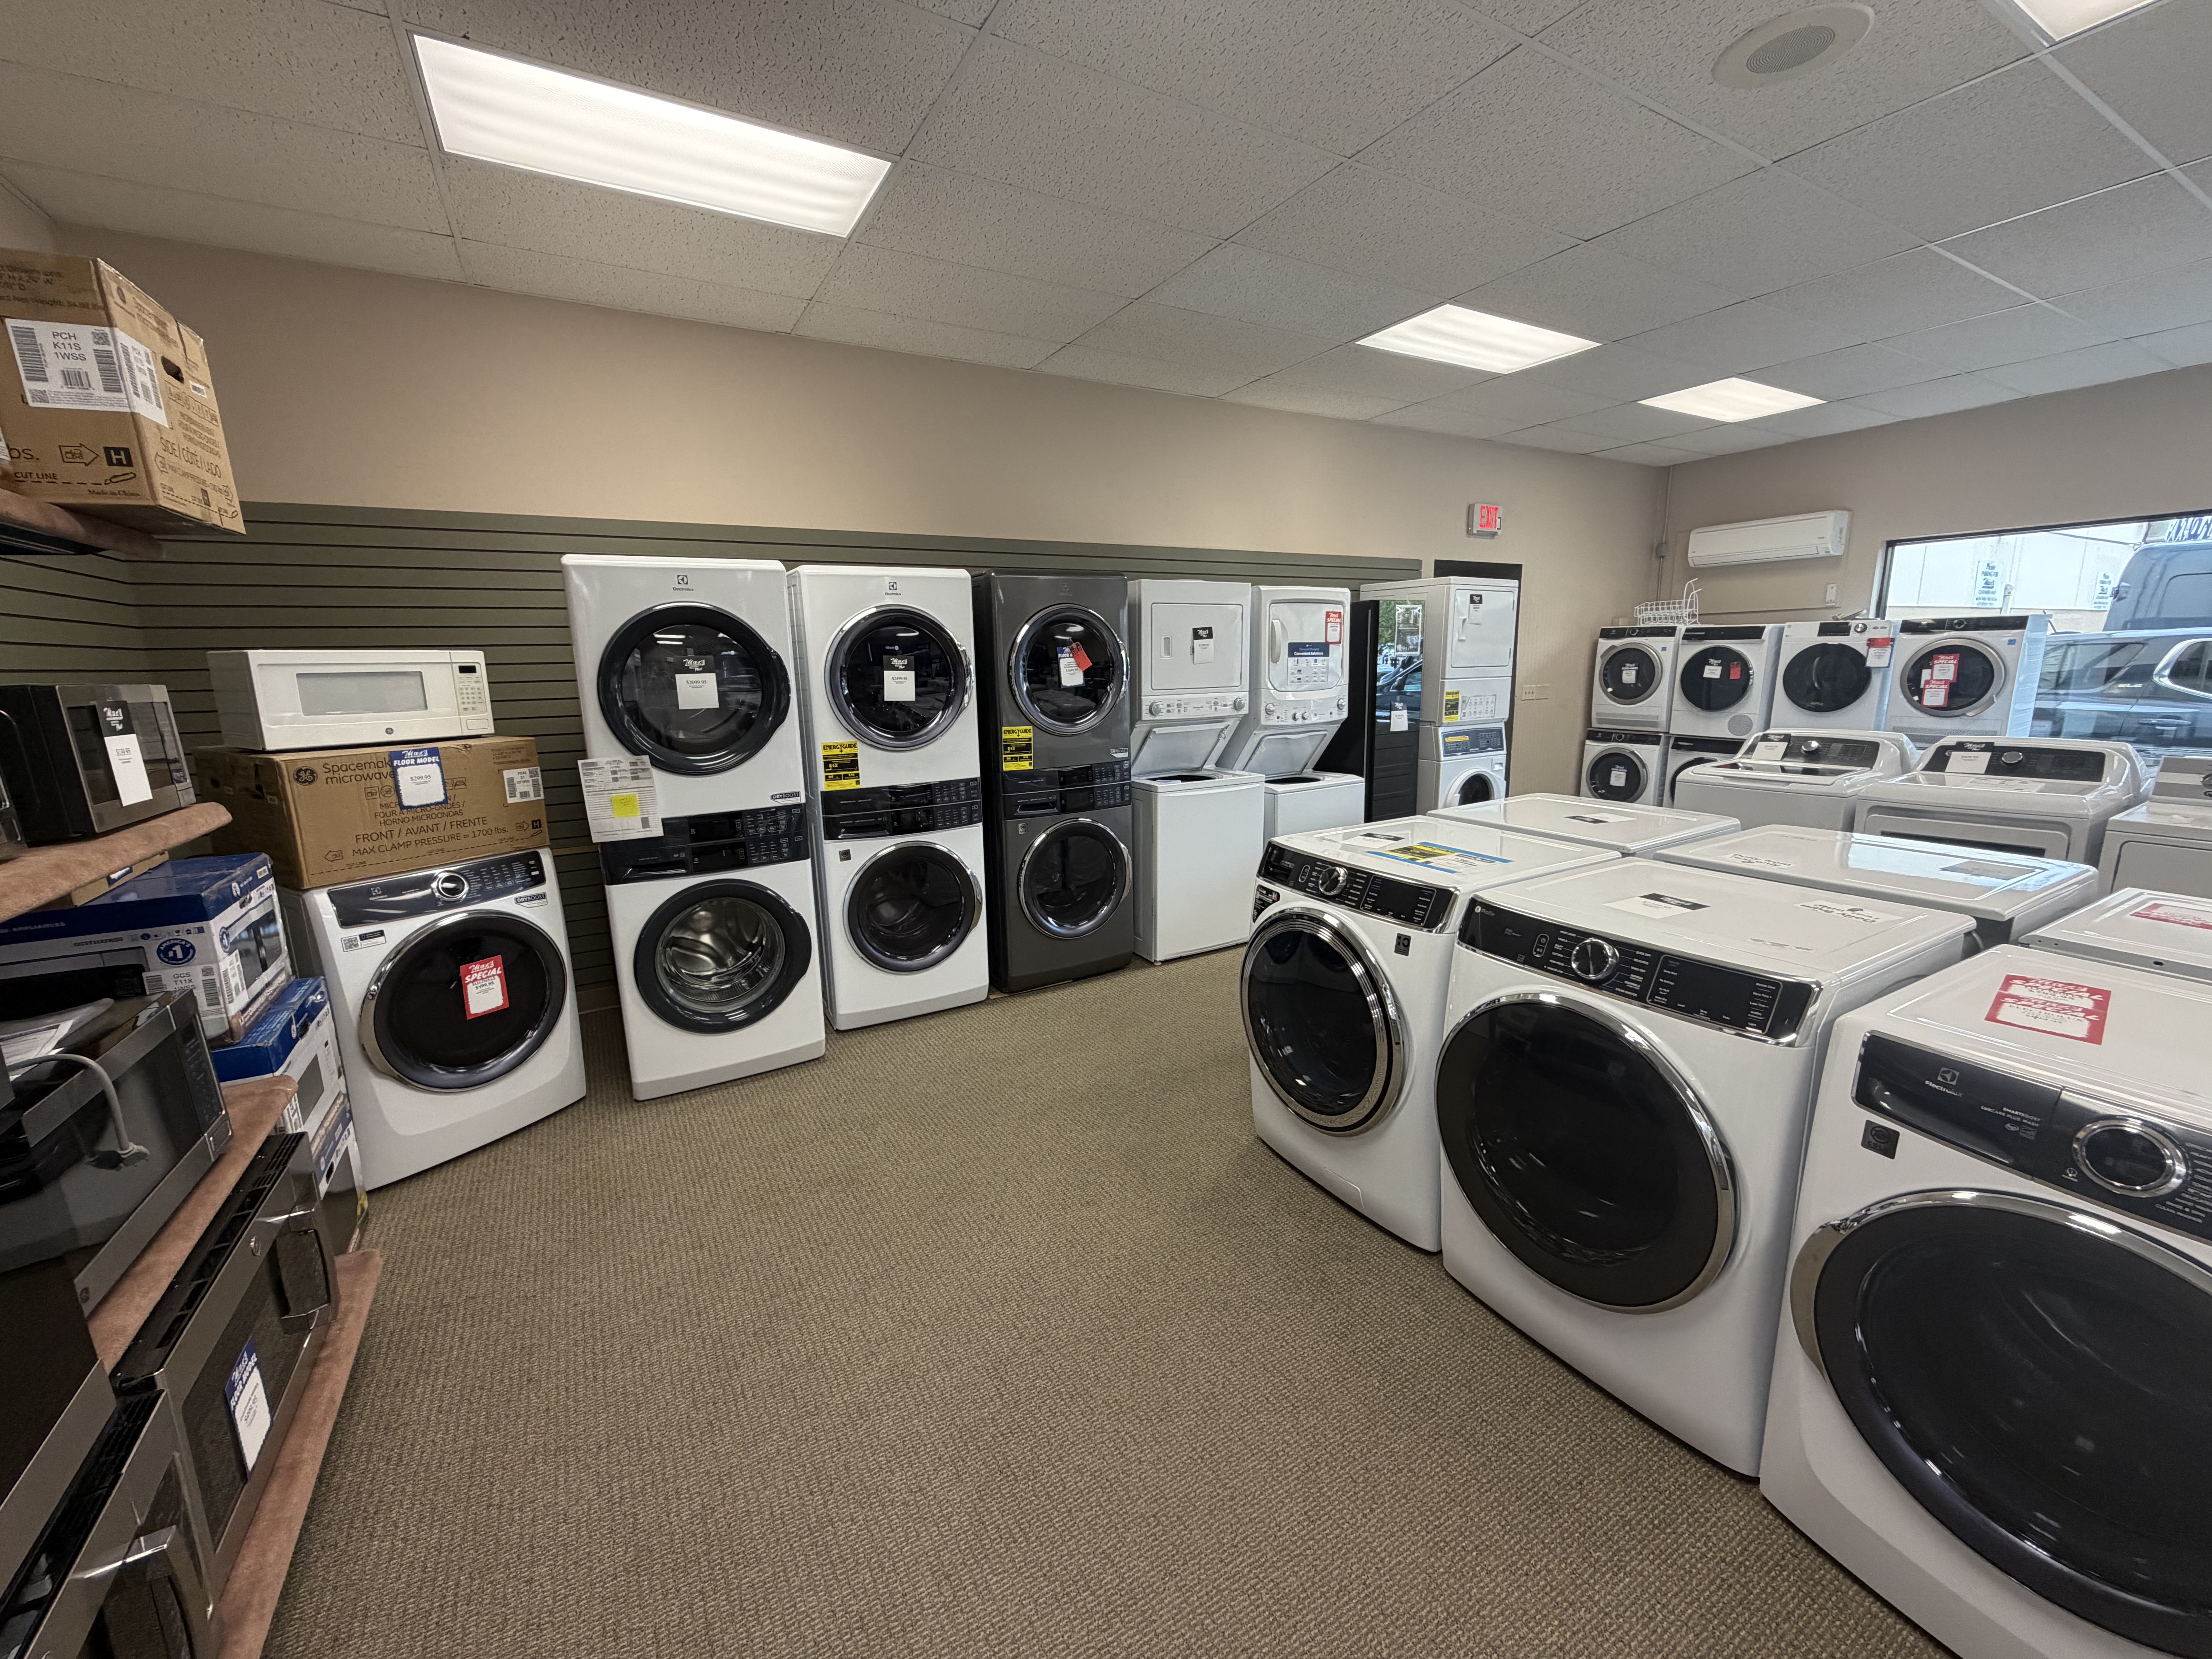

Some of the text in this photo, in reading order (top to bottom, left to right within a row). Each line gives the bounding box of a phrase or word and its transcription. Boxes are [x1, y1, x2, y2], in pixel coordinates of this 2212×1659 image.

[52, 331, 77, 340] PCH
[53, 341, 81, 350] K11S
[55, 352, 86, 361] 1WSS
[160, 437, 179, 457] SIDE
[205, 457, 221, 478] LADO
[1479, 505, 1499, 529] EXIT
[402, 749, 429, 758] Max's
[323, 757, 391, 774] Spacemak
[393, 756, 440, 766] FLOOR MODEL
[374, 810, 397, 819] FOUR
[380, 809, 464, 826] HORNO MICROONDAS
[355, 830, 394, 843] FRONT
[405, 823, 440, 836] AVANT
[450, 816, 488, 830] FRENTE
[352, 847, 376, 857] MAX
[378, 841, 412, 853] CLAMP
[415, 833, 461, 847] PRESSURE
[471, 830, 492, 839] 1700
[494, 826, 509, 835] lbs.
[517, 894, 546, 903] DRYBOOST
[160, 939, 191, 950] AMERICA'S
[168, 945, 183, 959] #1
[469, 960, 494, 973] Max's
[465, 967, 502, 983] SPECIAL
[2009, 979, 2104, 1000] SPECIAL
[2001, 998, 2100, 1020] SPECIAL
[2002, 1107, 2040, 1121] SMARTBOOST
